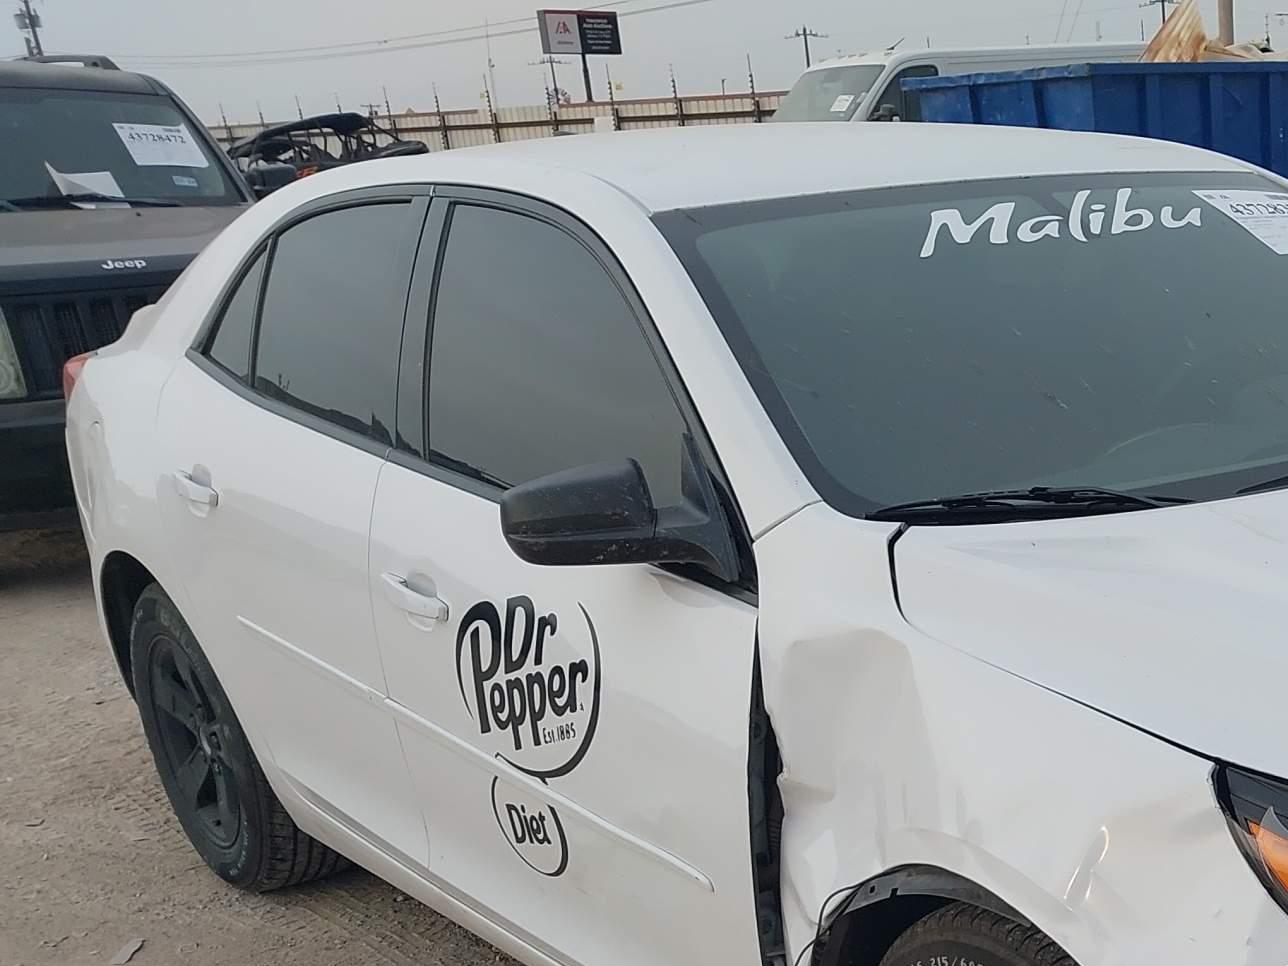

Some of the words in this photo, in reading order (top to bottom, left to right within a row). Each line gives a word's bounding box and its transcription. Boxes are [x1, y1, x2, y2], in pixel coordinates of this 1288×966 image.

[920, 187, 1203, 258] Malibu
[101, 258, 147, 270] Jeep
[504, 595, 558, 674] Dr
[456, 601, 589, 751] Pepper
[505, 804, 551, 845] Diet
